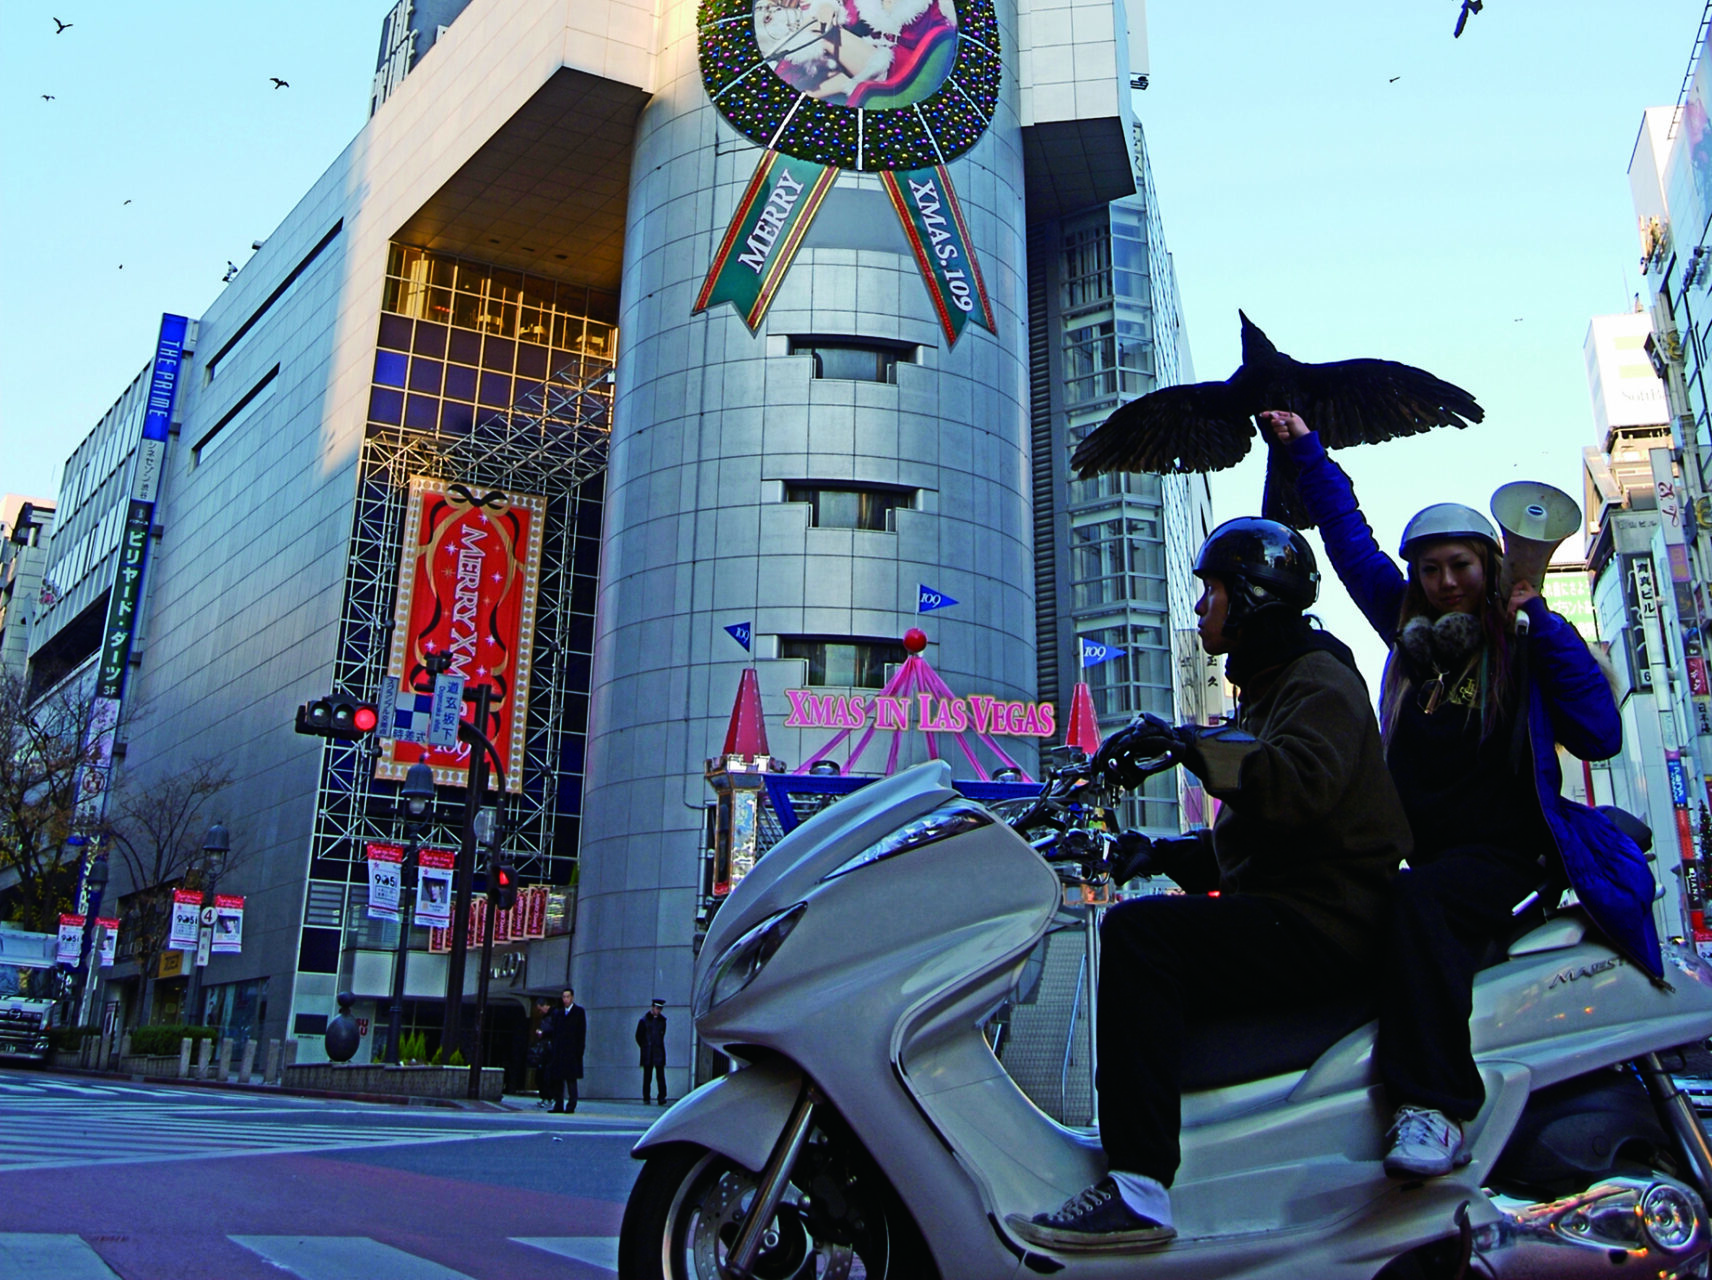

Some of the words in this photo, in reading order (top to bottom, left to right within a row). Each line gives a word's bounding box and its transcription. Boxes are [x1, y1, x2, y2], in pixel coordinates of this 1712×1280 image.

[738, 168, 804, 274] MERRY
[158, 340, 180, 366] THE
[149, 370, 175, 418] PRIME
[453, 524, 488, 631] MERRY
[920, 591, 942, 608] 109
[735, 626, 750, 643] 109
[1083, 645, 1107, 660] 109
[441, 681, 459, 741] 道玄坂下
[784, 689, 866, 729] XMAS
[874, 695, 910, 730] IN
[917, 693, 967, 732] LAS
[967, 695, 1055, 737] VEGAS
[204, 909, 212, 922] 4
[1548, 956, 1623, 990] MAJEST
